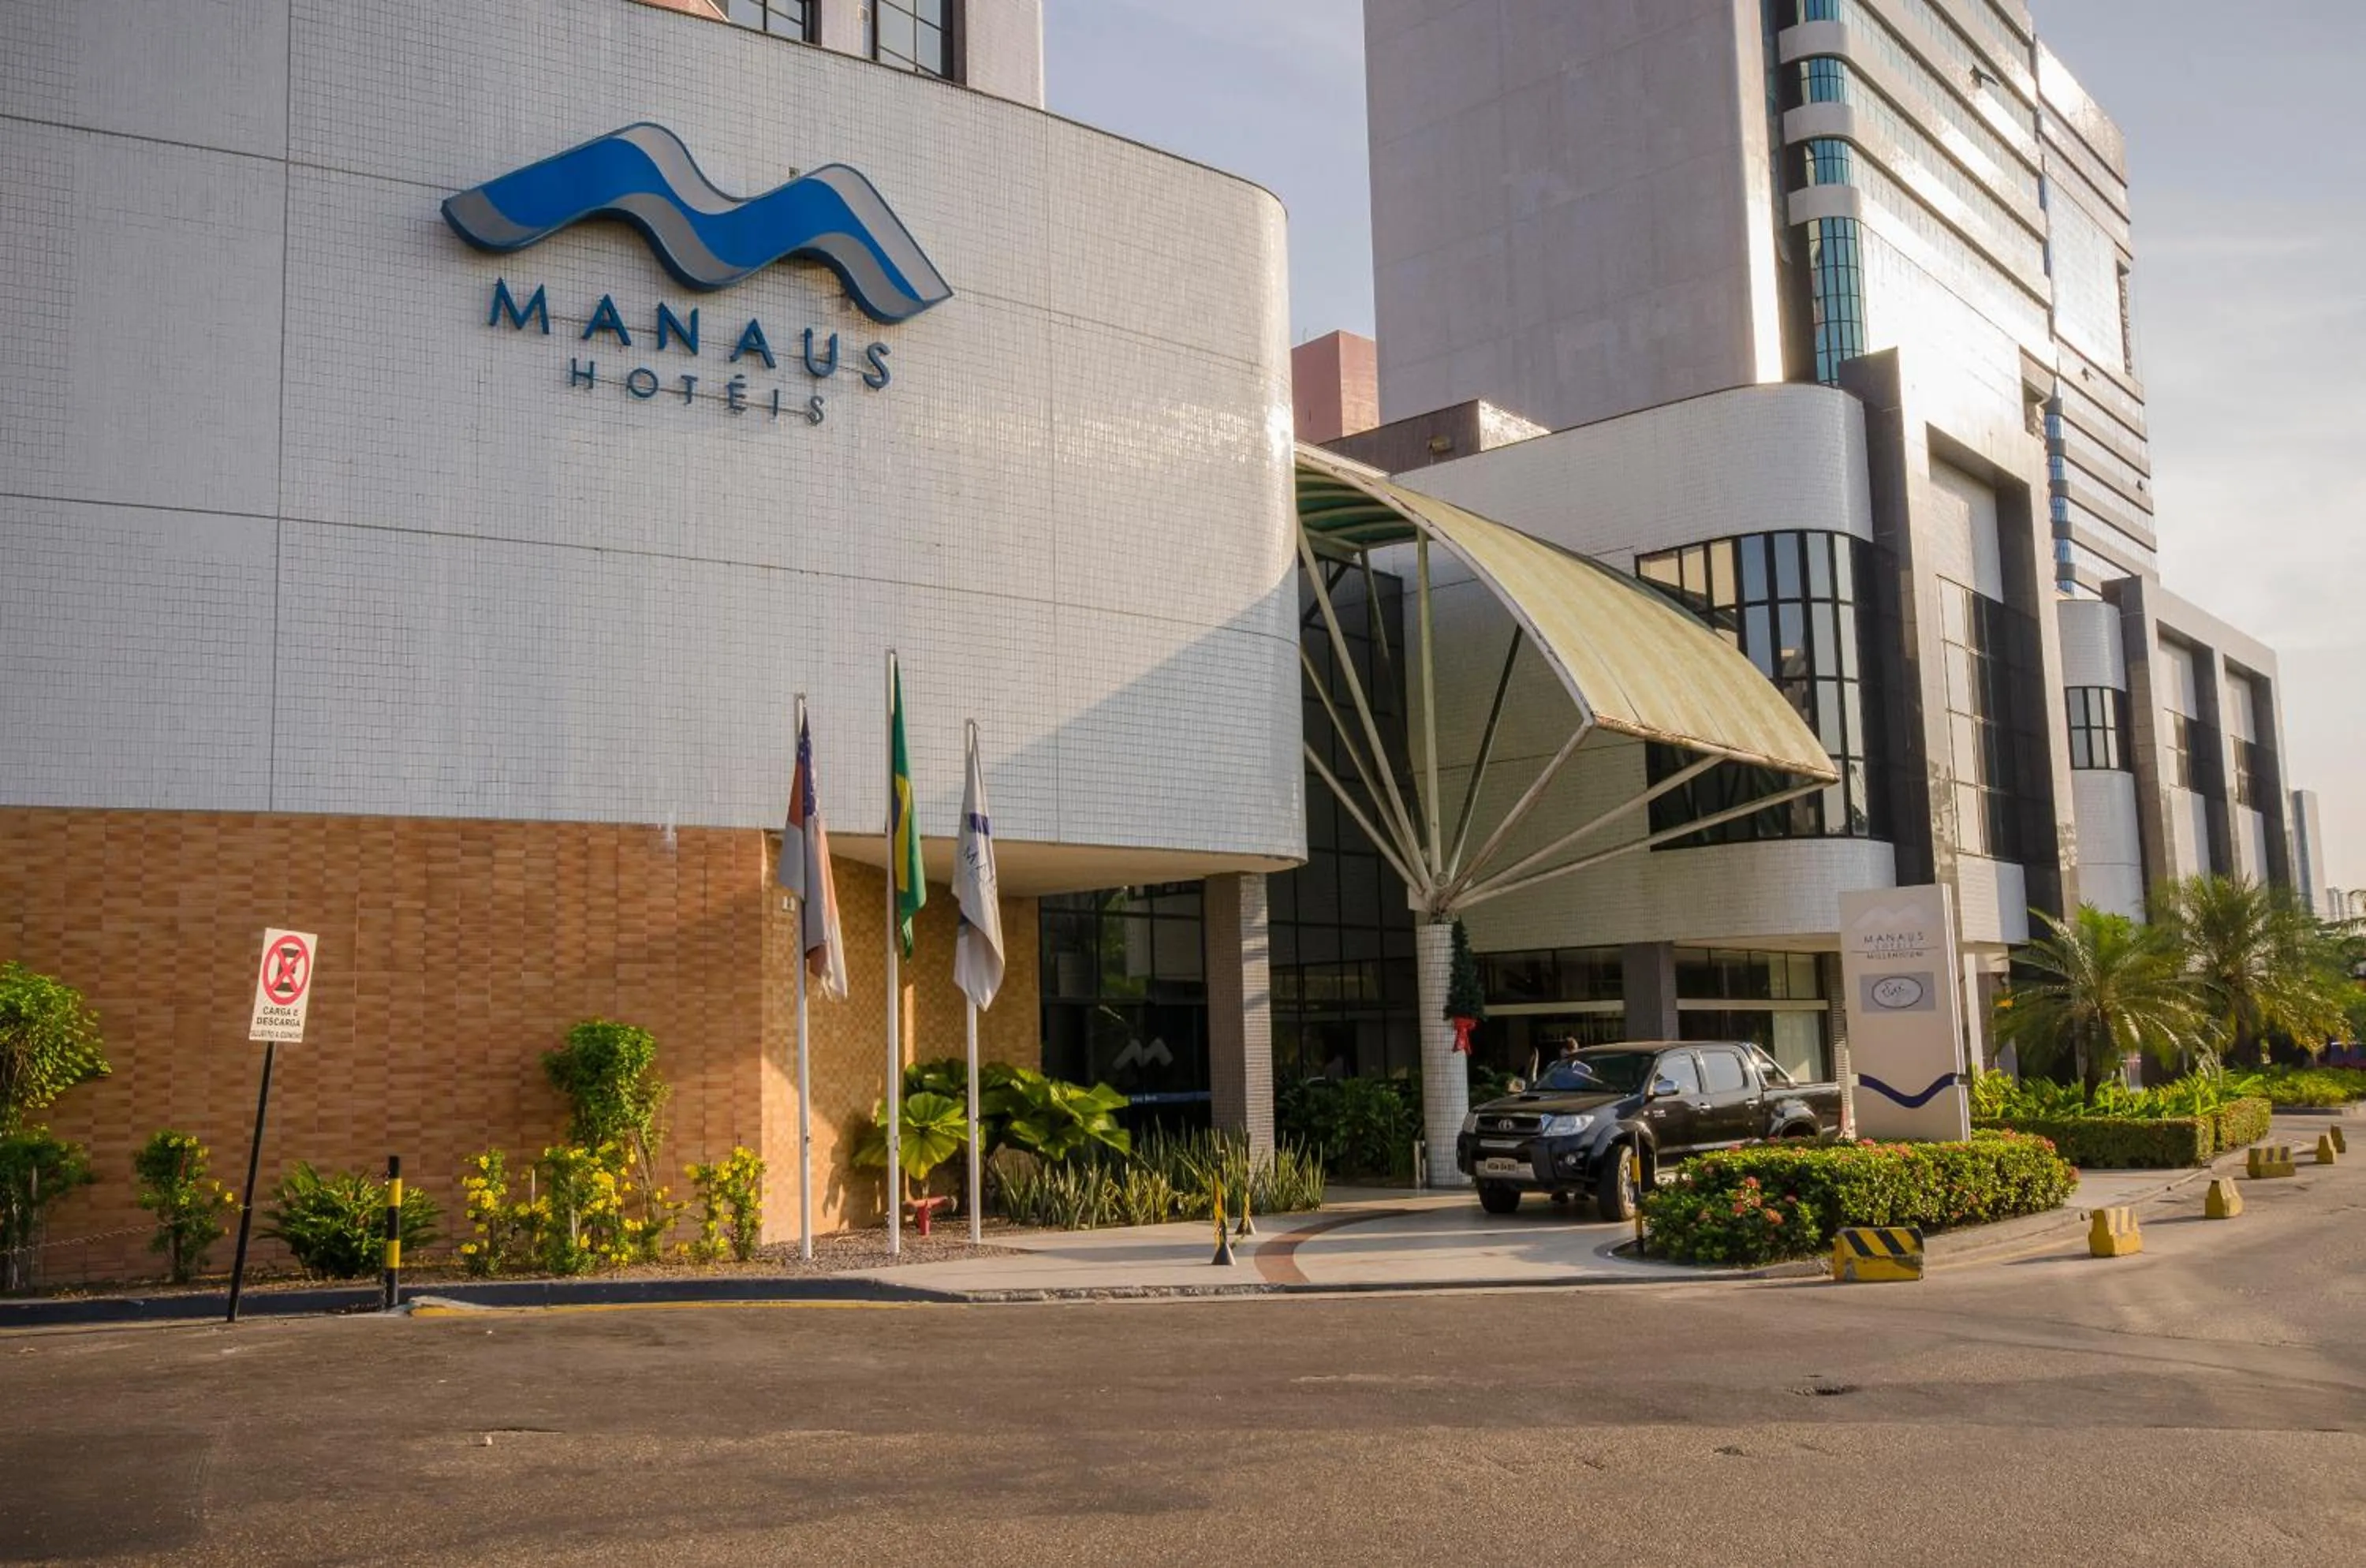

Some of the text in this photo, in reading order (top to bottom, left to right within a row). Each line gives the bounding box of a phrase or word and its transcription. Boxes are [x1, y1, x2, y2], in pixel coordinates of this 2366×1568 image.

[488, 277, 892, 390] MANAUS
[570, 357, 825, 426] HOTÉIS
[1864, 931, 1924, 943] MANAUS
[263, 1006, 291, 1016] CARGA
[256, 1017, 300, 1027] DESCARGA
